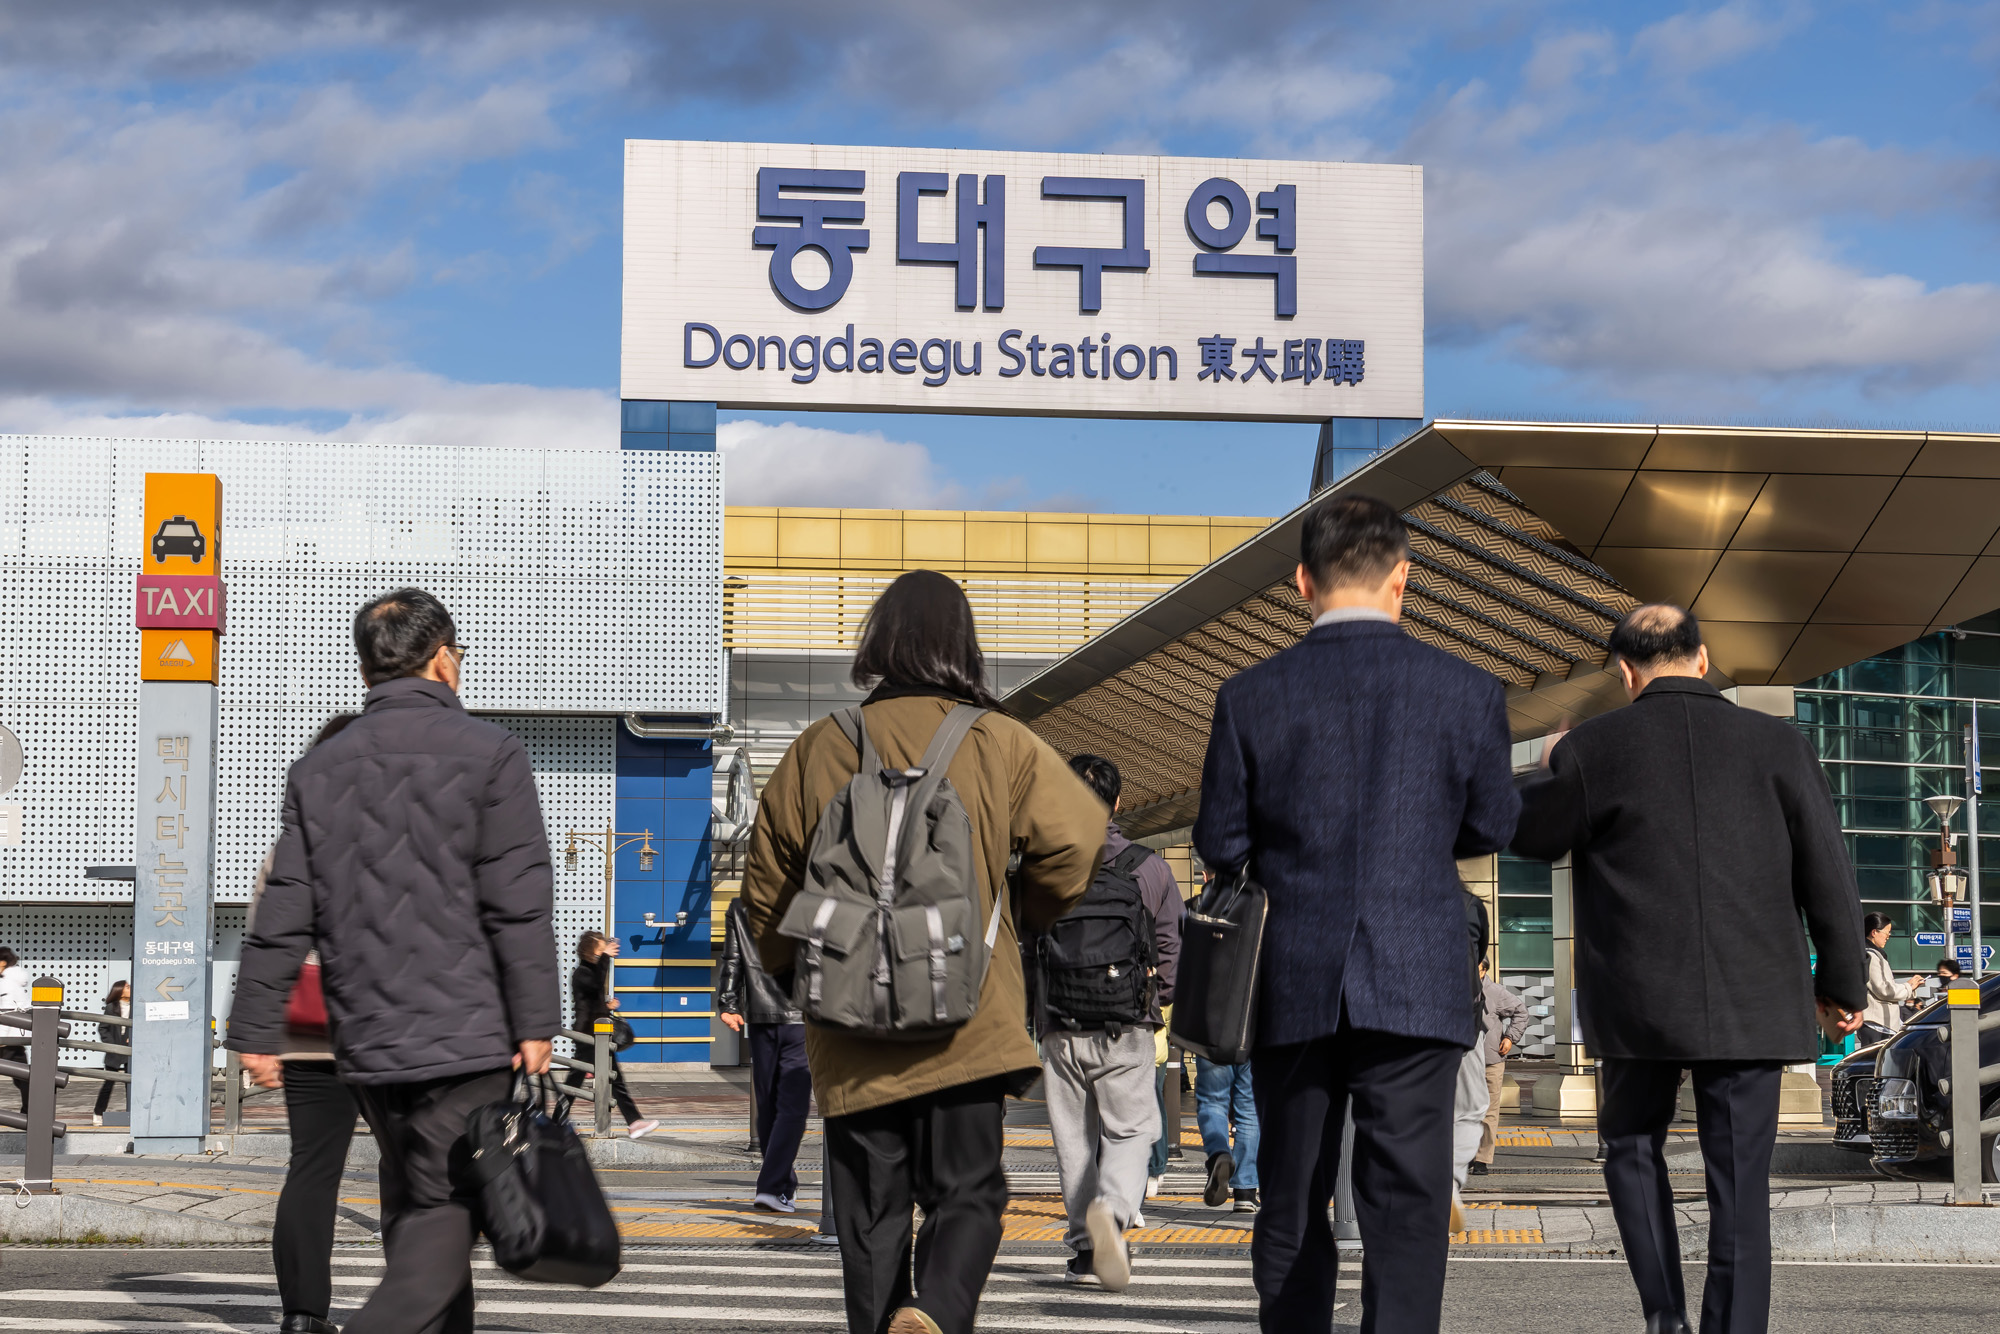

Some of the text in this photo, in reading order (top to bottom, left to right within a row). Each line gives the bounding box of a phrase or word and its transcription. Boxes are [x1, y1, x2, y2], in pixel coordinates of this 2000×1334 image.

[753, 165, 1297, 318] 동대구역
[683, 321, 1179, 387] Dongdaegu Station
[1196, 333, 1366, 386] 東大邱驛
[140, 587, 214, 616] TAXI
[142, 957, 183, 966] Dongdaegu
[183, 957, 197, 965] Stn.
[144, 941, 194, 955] 동대구역
